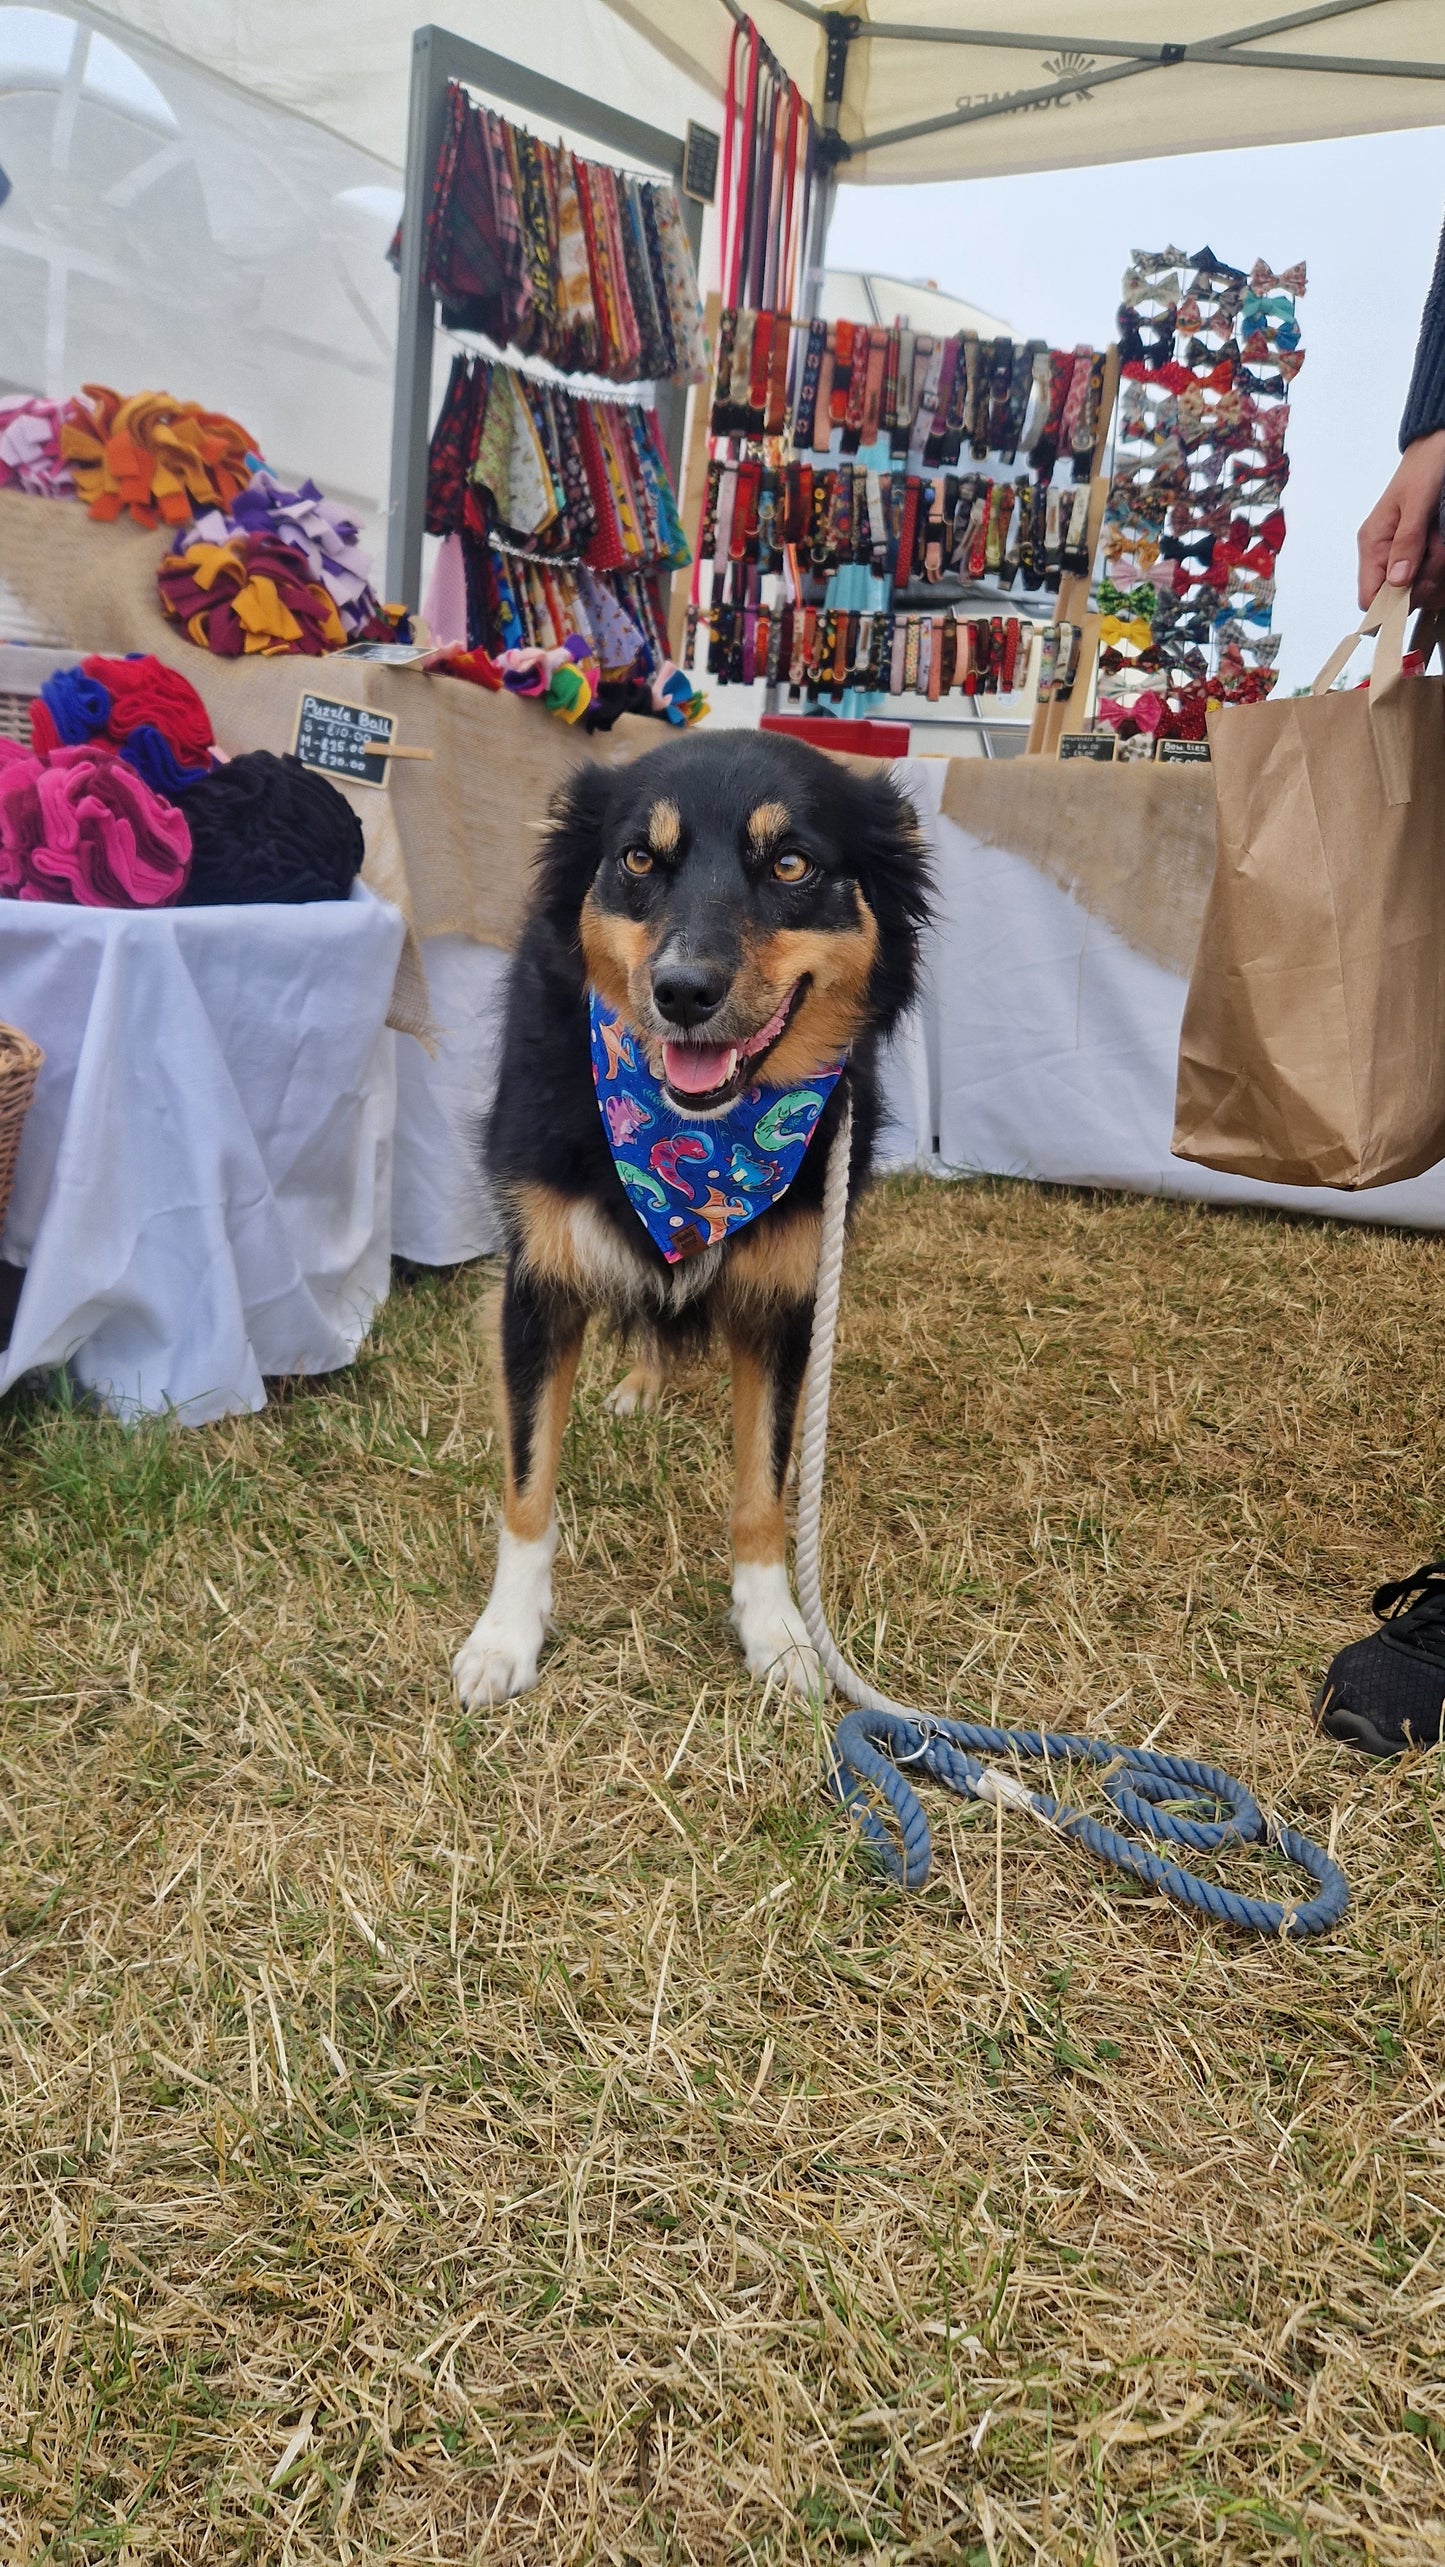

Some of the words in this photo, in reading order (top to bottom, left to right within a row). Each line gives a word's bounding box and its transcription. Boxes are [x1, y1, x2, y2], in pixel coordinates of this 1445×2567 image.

[304, 698, 350, 721] Puzzle
[357, 711, 391, 734] Ball
[1164, 742, 1184, 751] Bow
[1186, 743, 1206, 752] ties
